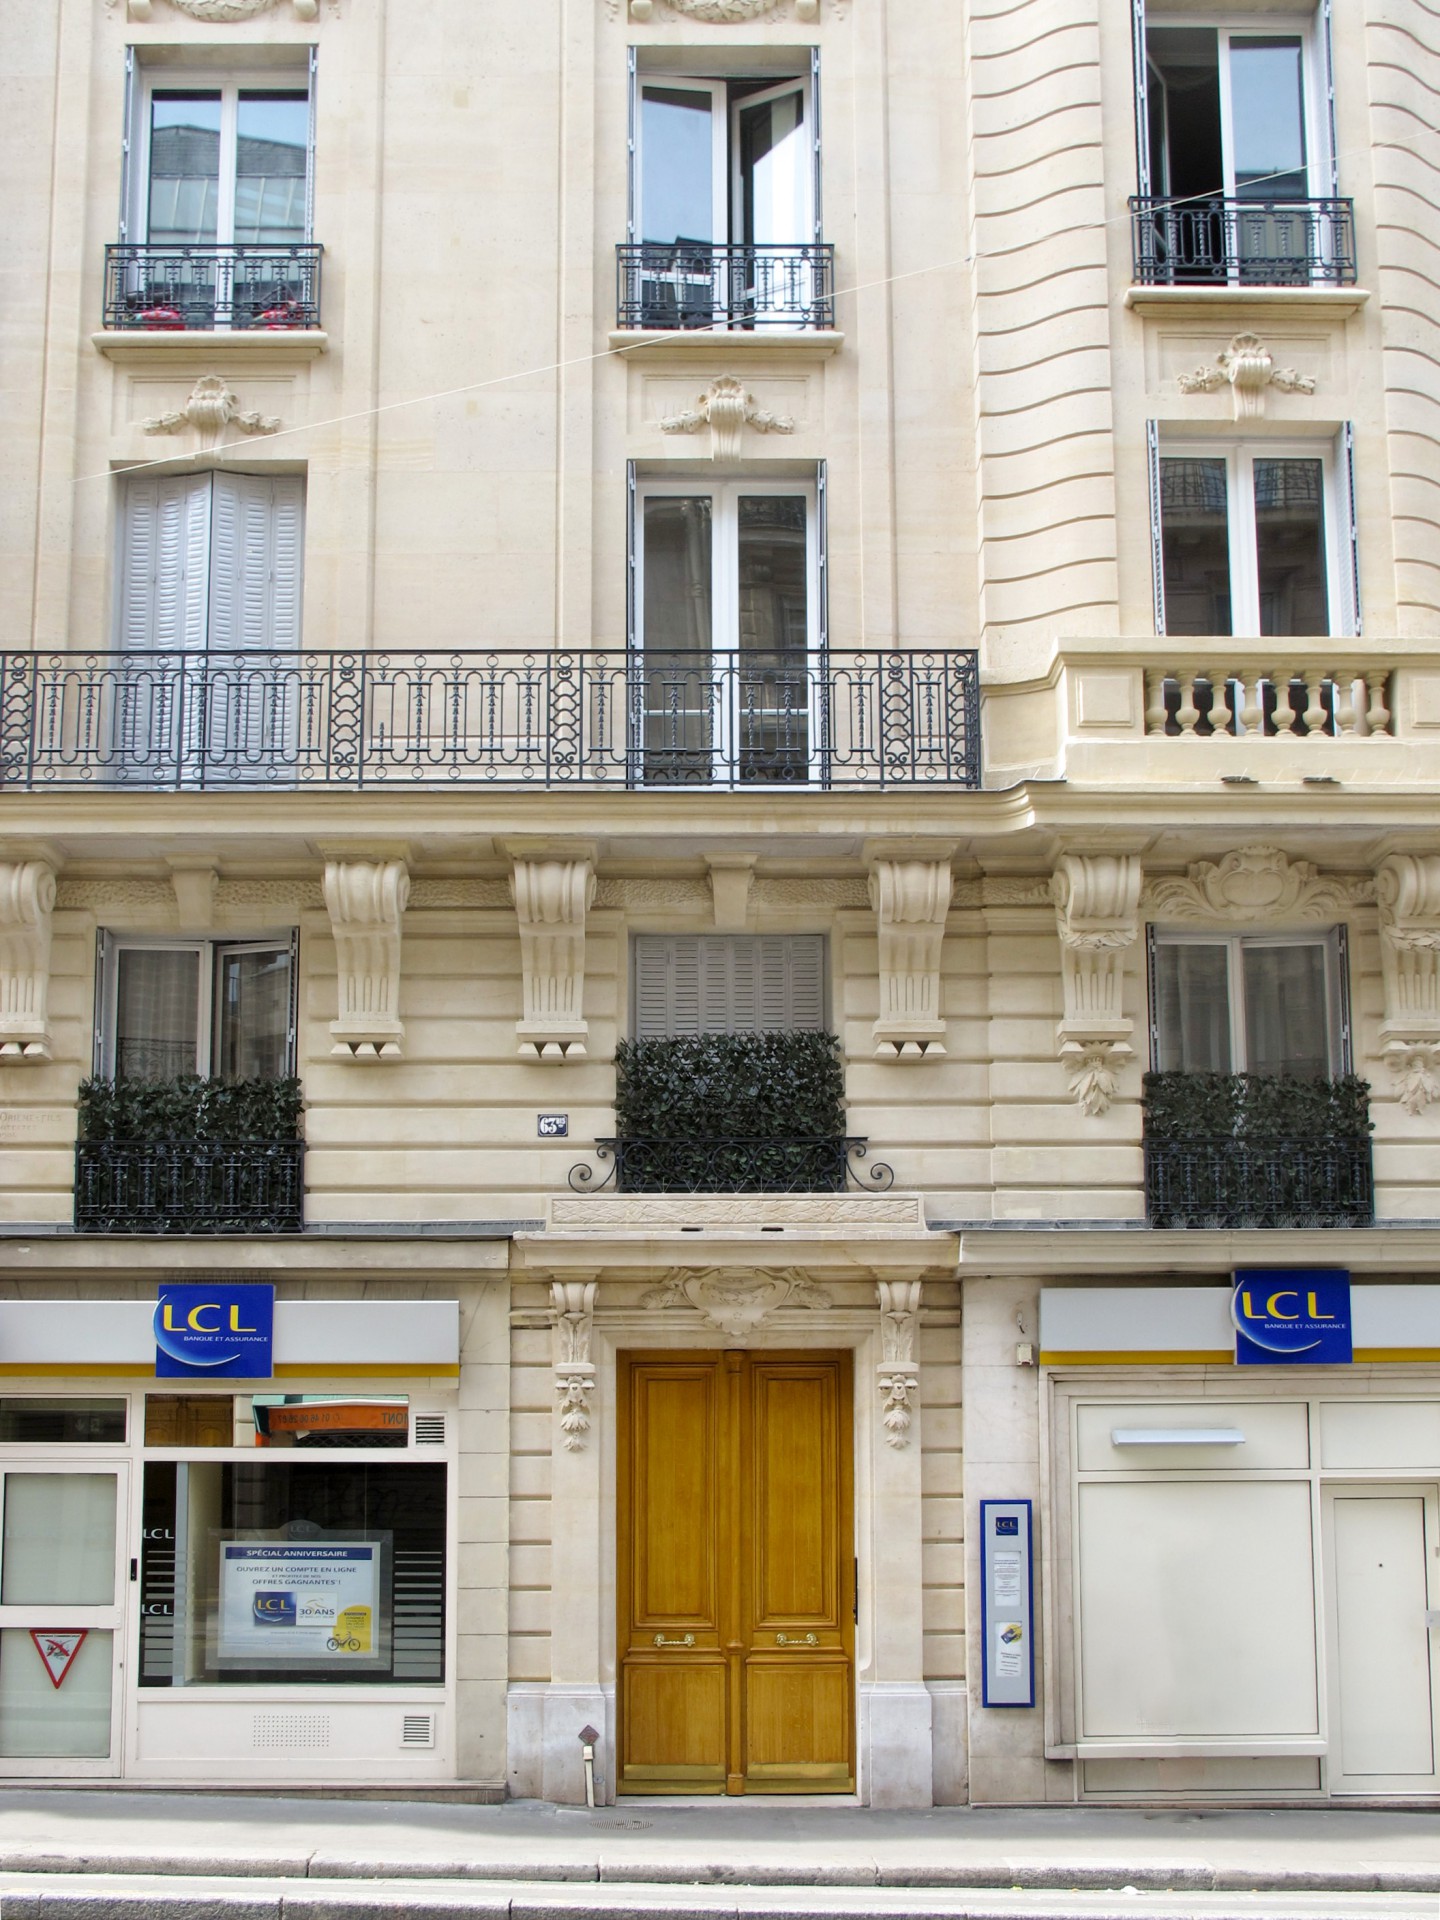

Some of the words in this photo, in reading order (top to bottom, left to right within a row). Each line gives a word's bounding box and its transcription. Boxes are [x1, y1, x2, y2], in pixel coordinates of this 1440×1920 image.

[1242, 1291, 1335, 1320] LCL
[163, 1304, 257, 1332] LCL
[143, 1528, 174, 1539] LCL
[246, 1549, 282, 1557] SPÉCIAL
[141, 1603, 173, 1614] LCL
[257, 1599, 290, 1610] LCL
